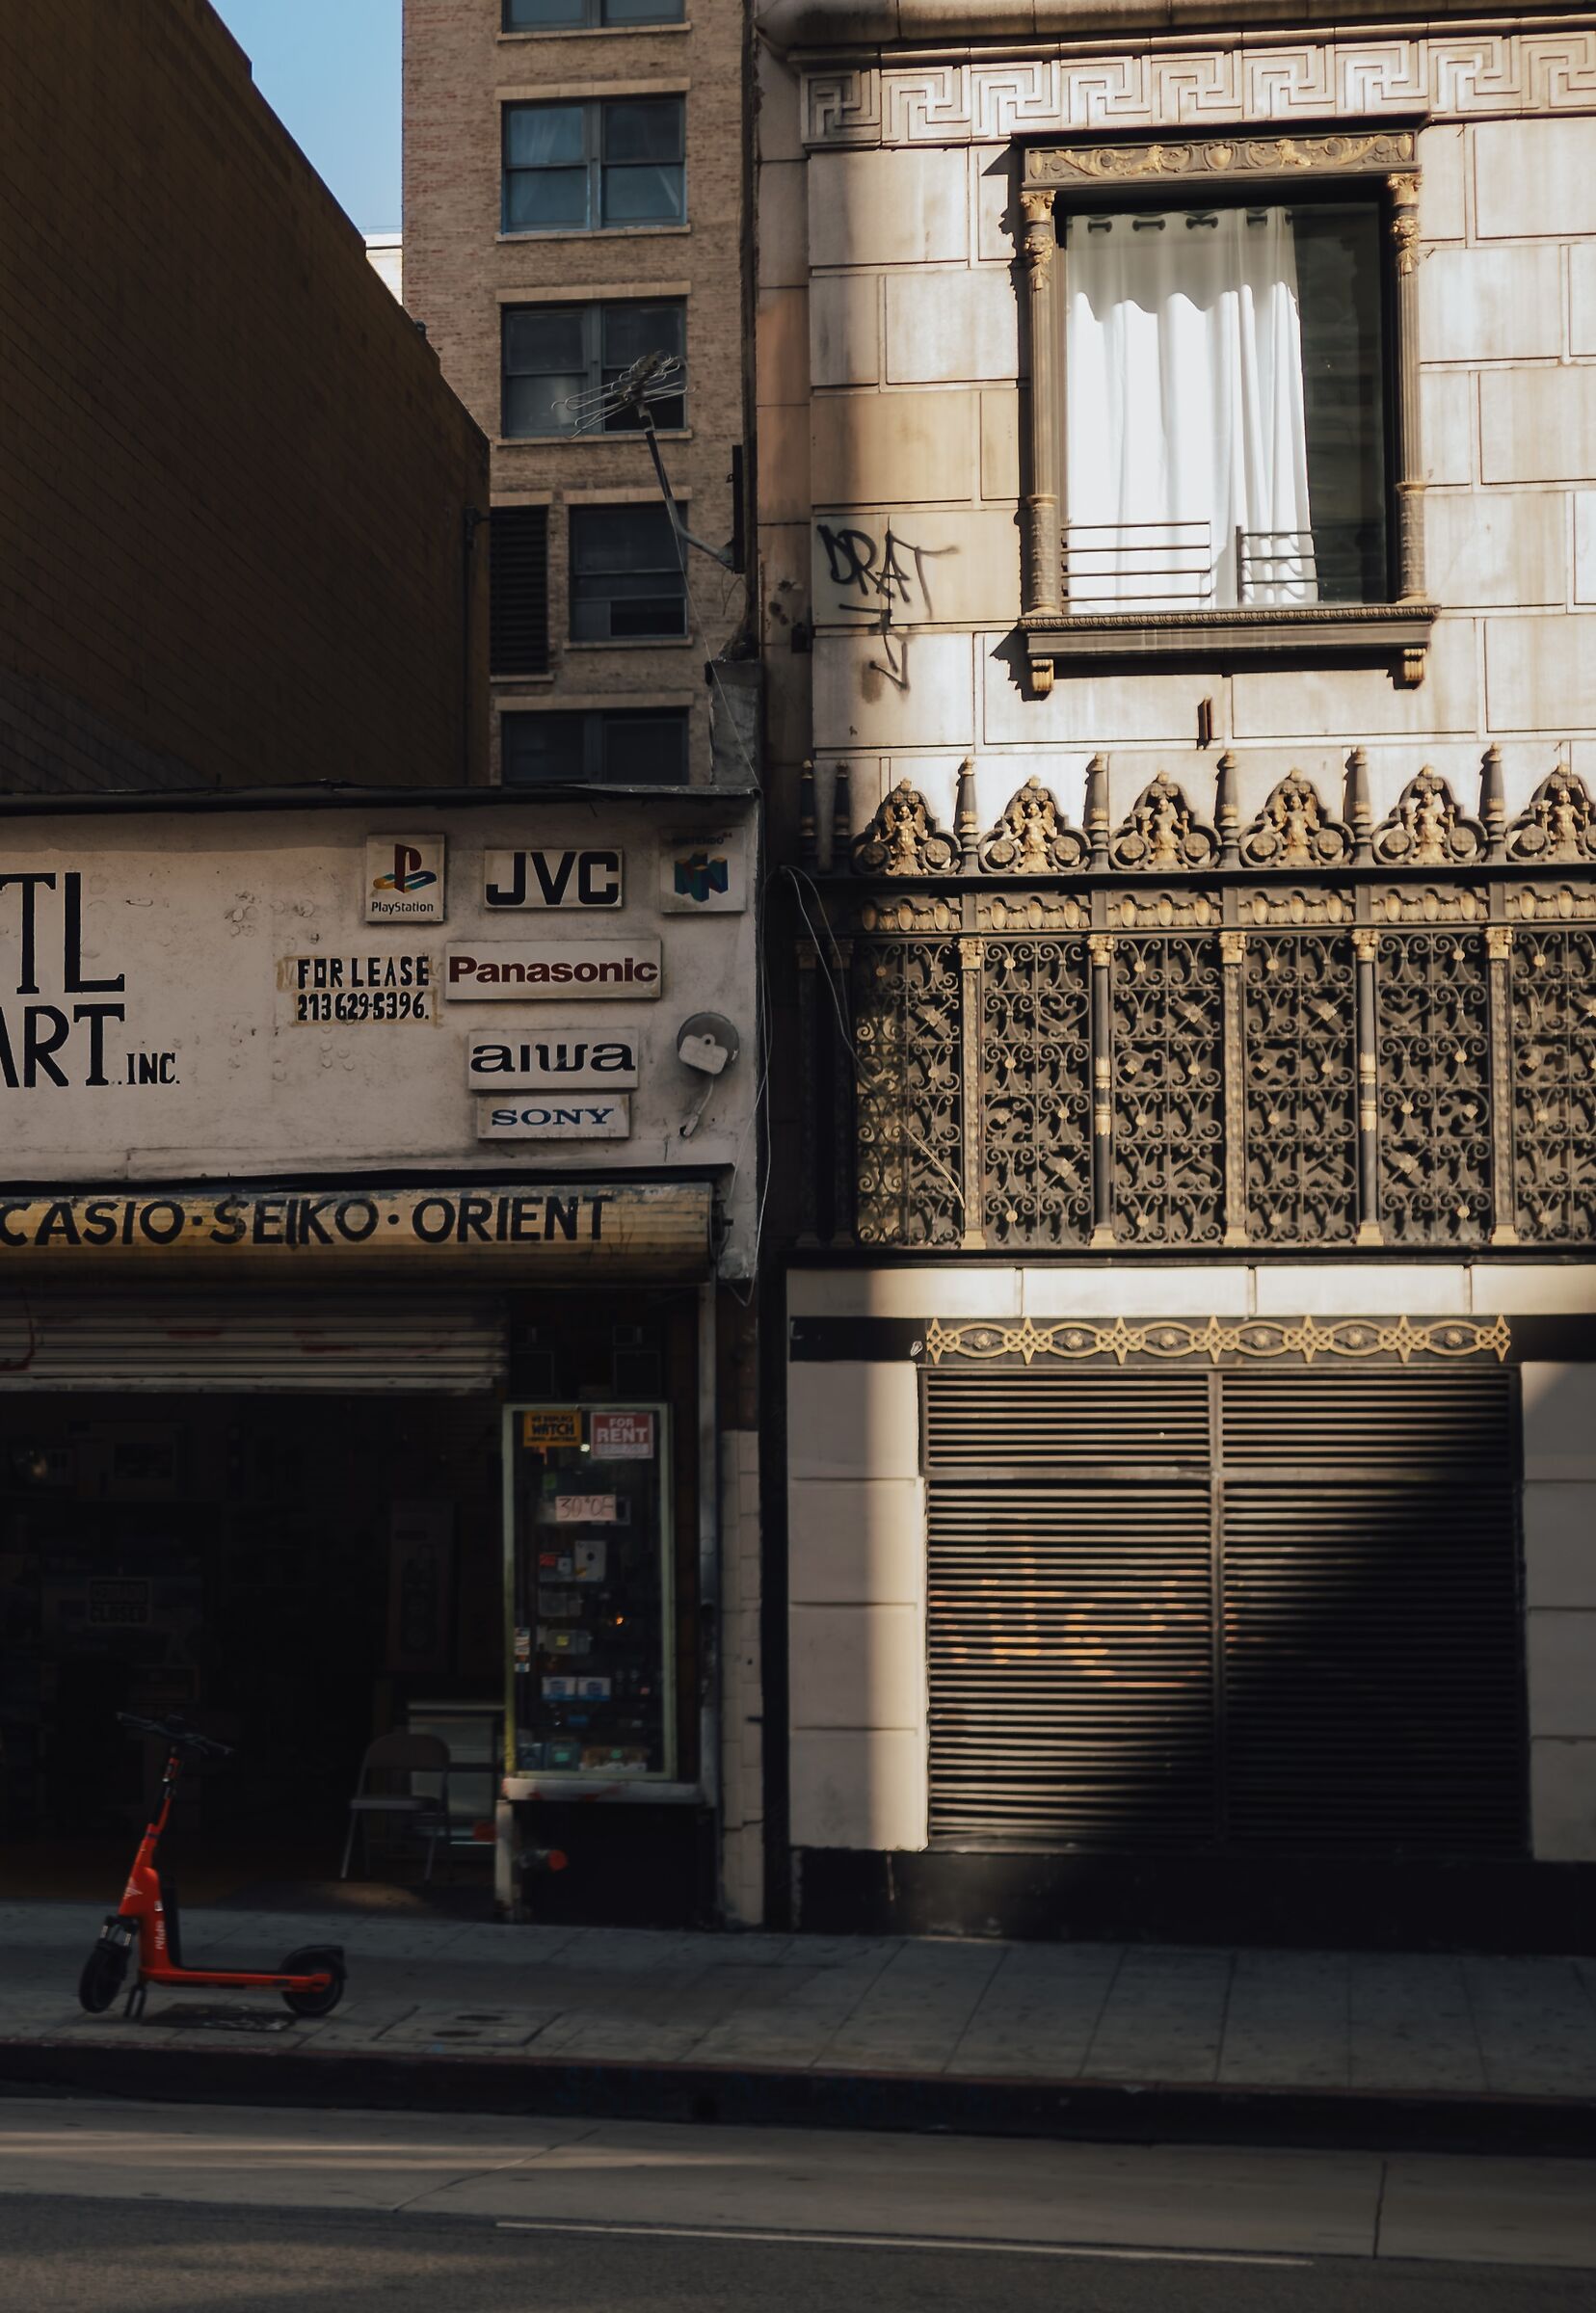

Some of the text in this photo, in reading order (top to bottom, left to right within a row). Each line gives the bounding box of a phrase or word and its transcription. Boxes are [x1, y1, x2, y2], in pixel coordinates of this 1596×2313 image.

[486, 850, 620, 906] JVC
[371, 901, 434, 915] PlayStation
[297, 956, 430, 990] FOR LEASE
[449, 955, 658, 984] Panasonic
[470, 1043, 636, 1074] aiwa
[491, 1108, 615, 1127] SONY
[0, 1195, 615, 1247] CASIO SEIKO ORIENT
[532, 1423, 572, 1435] WATCH
[609, 1417, 634, 1427] FOR
[597, 1427, 649, 1443] RENT
